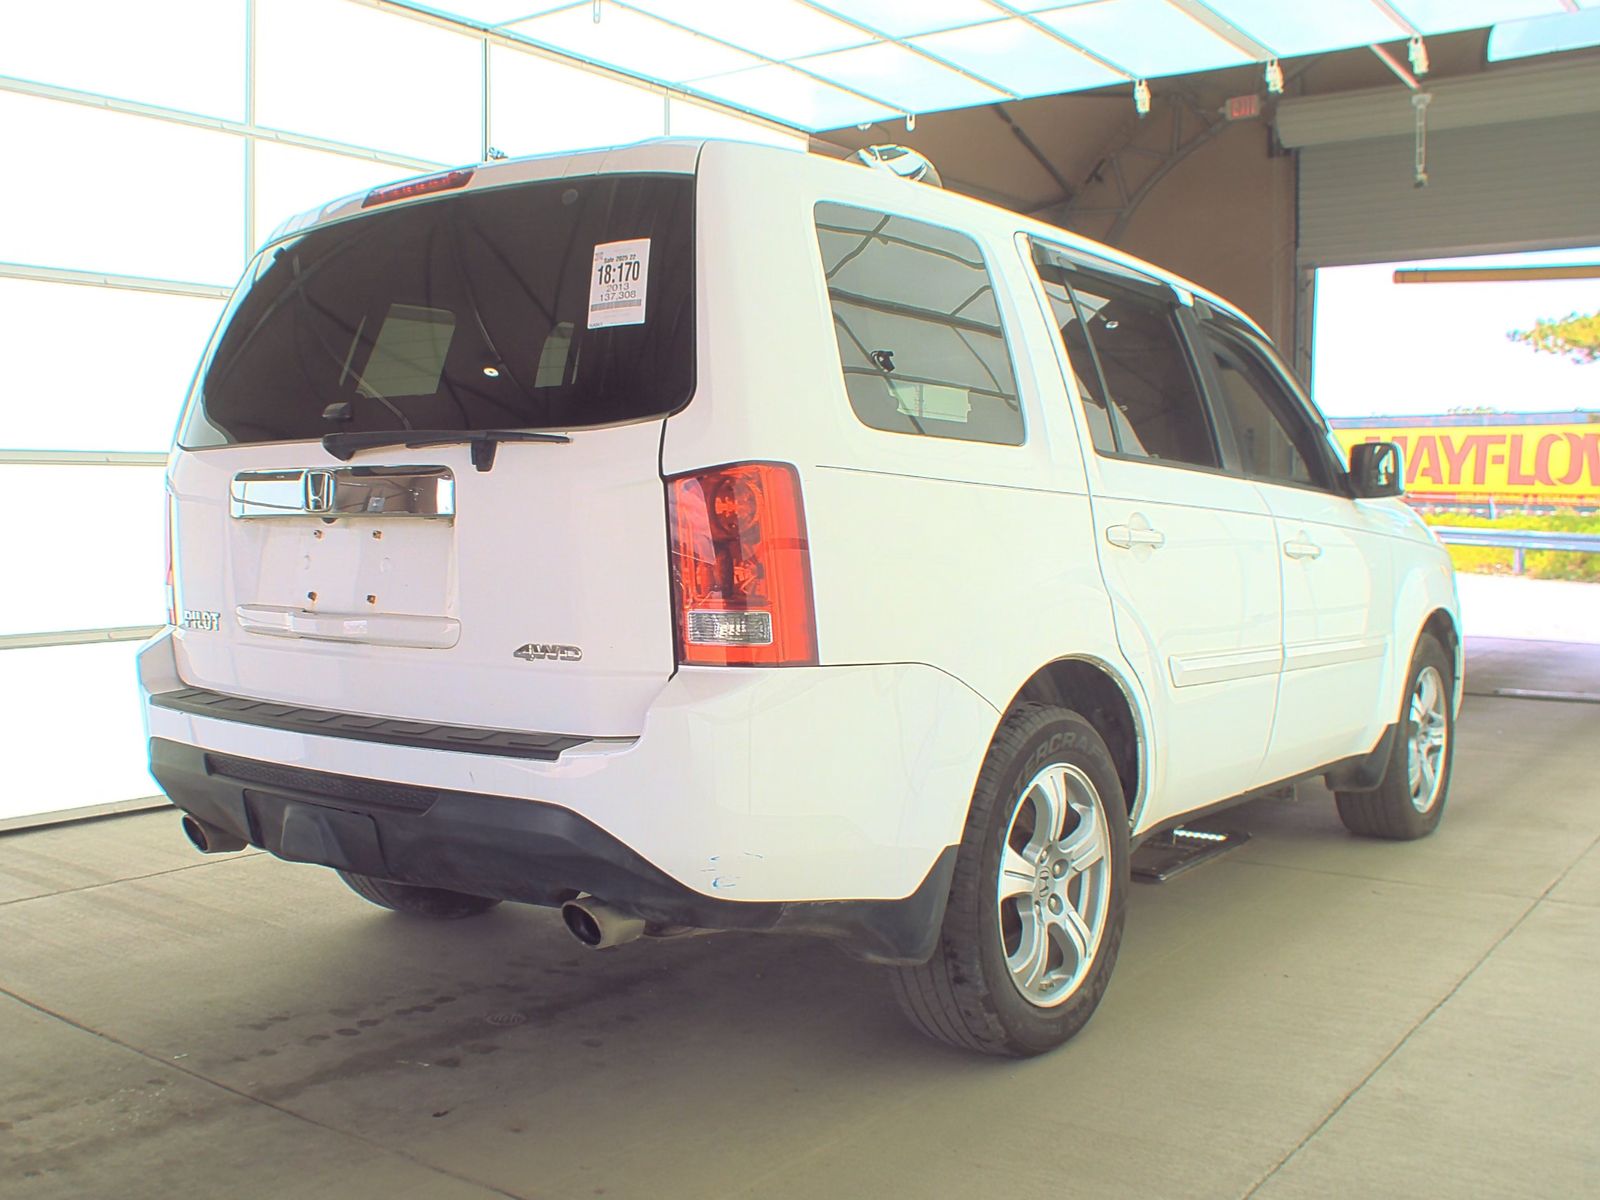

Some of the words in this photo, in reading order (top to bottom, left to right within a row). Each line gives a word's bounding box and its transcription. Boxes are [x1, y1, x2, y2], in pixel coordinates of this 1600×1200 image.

[598, 261, 640, 285] 18:170
[600, 290, 637, 302] 137,308
[606, 283, 630, 293] 2013
[183, 609, 221, 632] PILOT
[513, 643, 582, 661] 4WD
